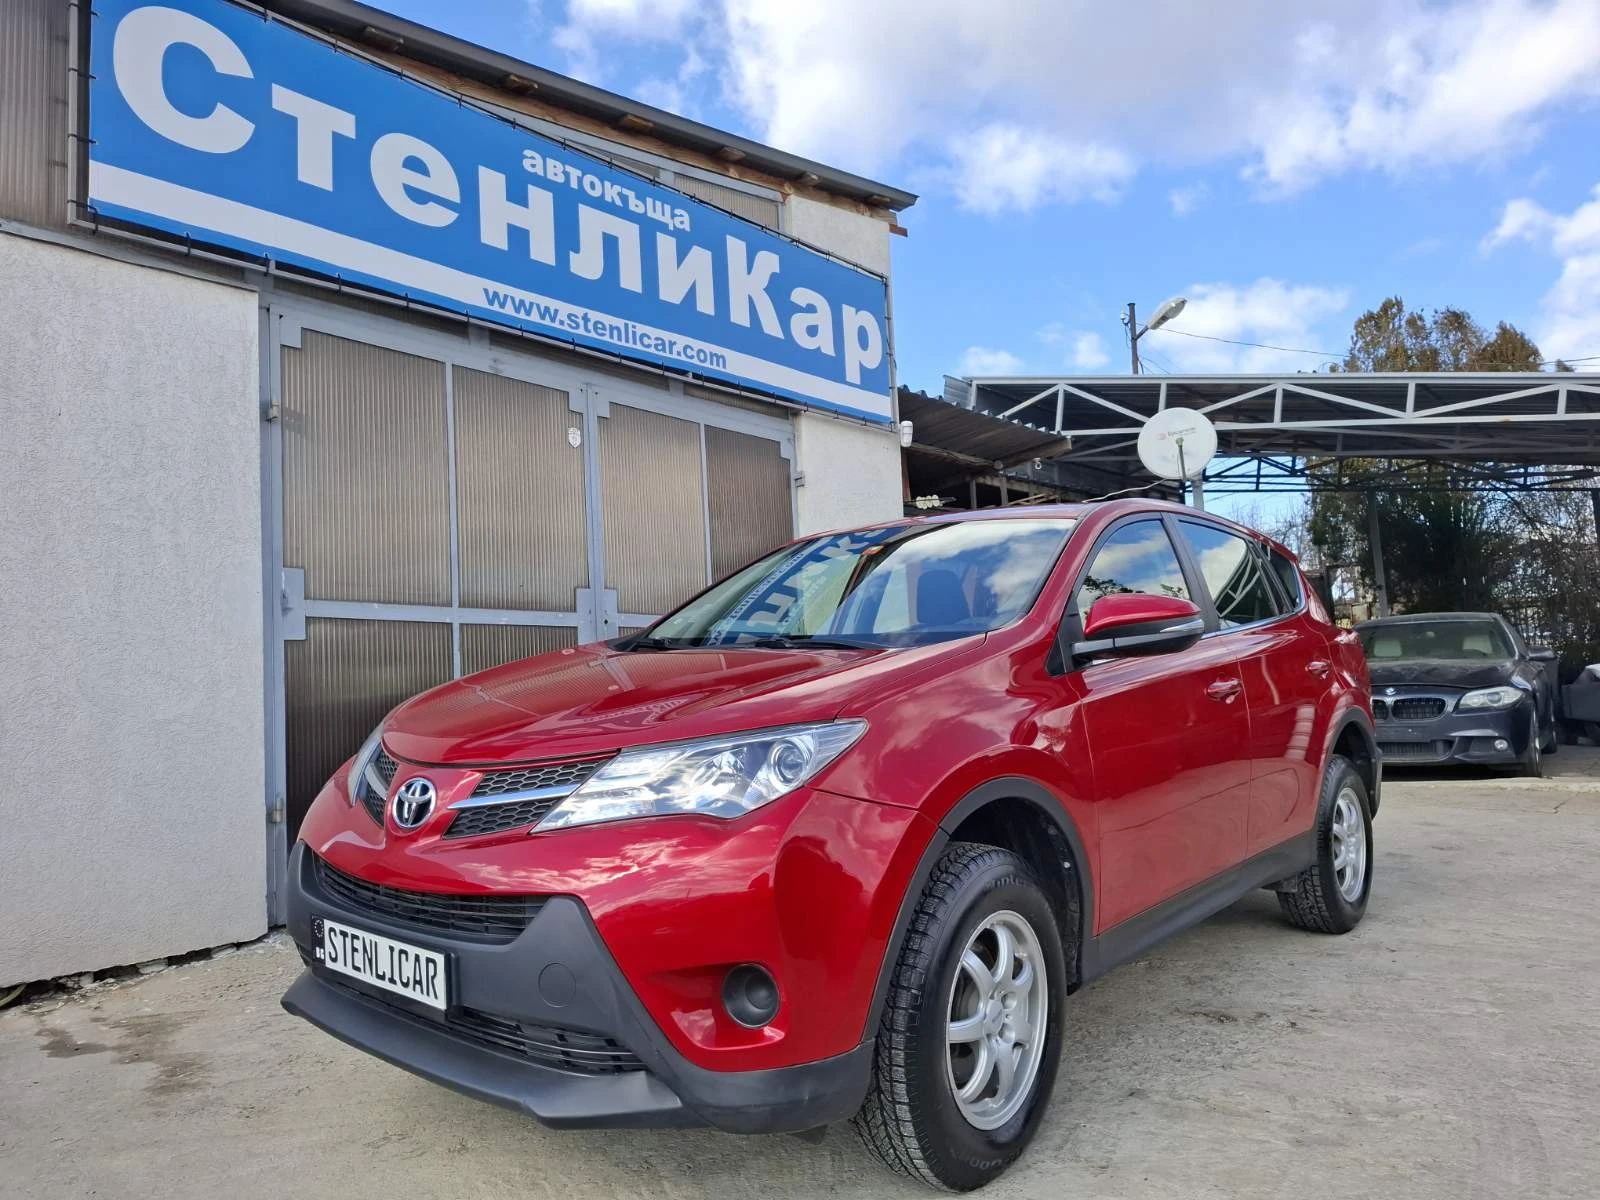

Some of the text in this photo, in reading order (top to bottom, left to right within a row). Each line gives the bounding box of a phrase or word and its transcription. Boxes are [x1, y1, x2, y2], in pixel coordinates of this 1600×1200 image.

[522, 147, 691, 232] автокъща
[483, 287, 727, 371] www.stenlicar.com
[327, 926, 439, 1000] STENLICAR
